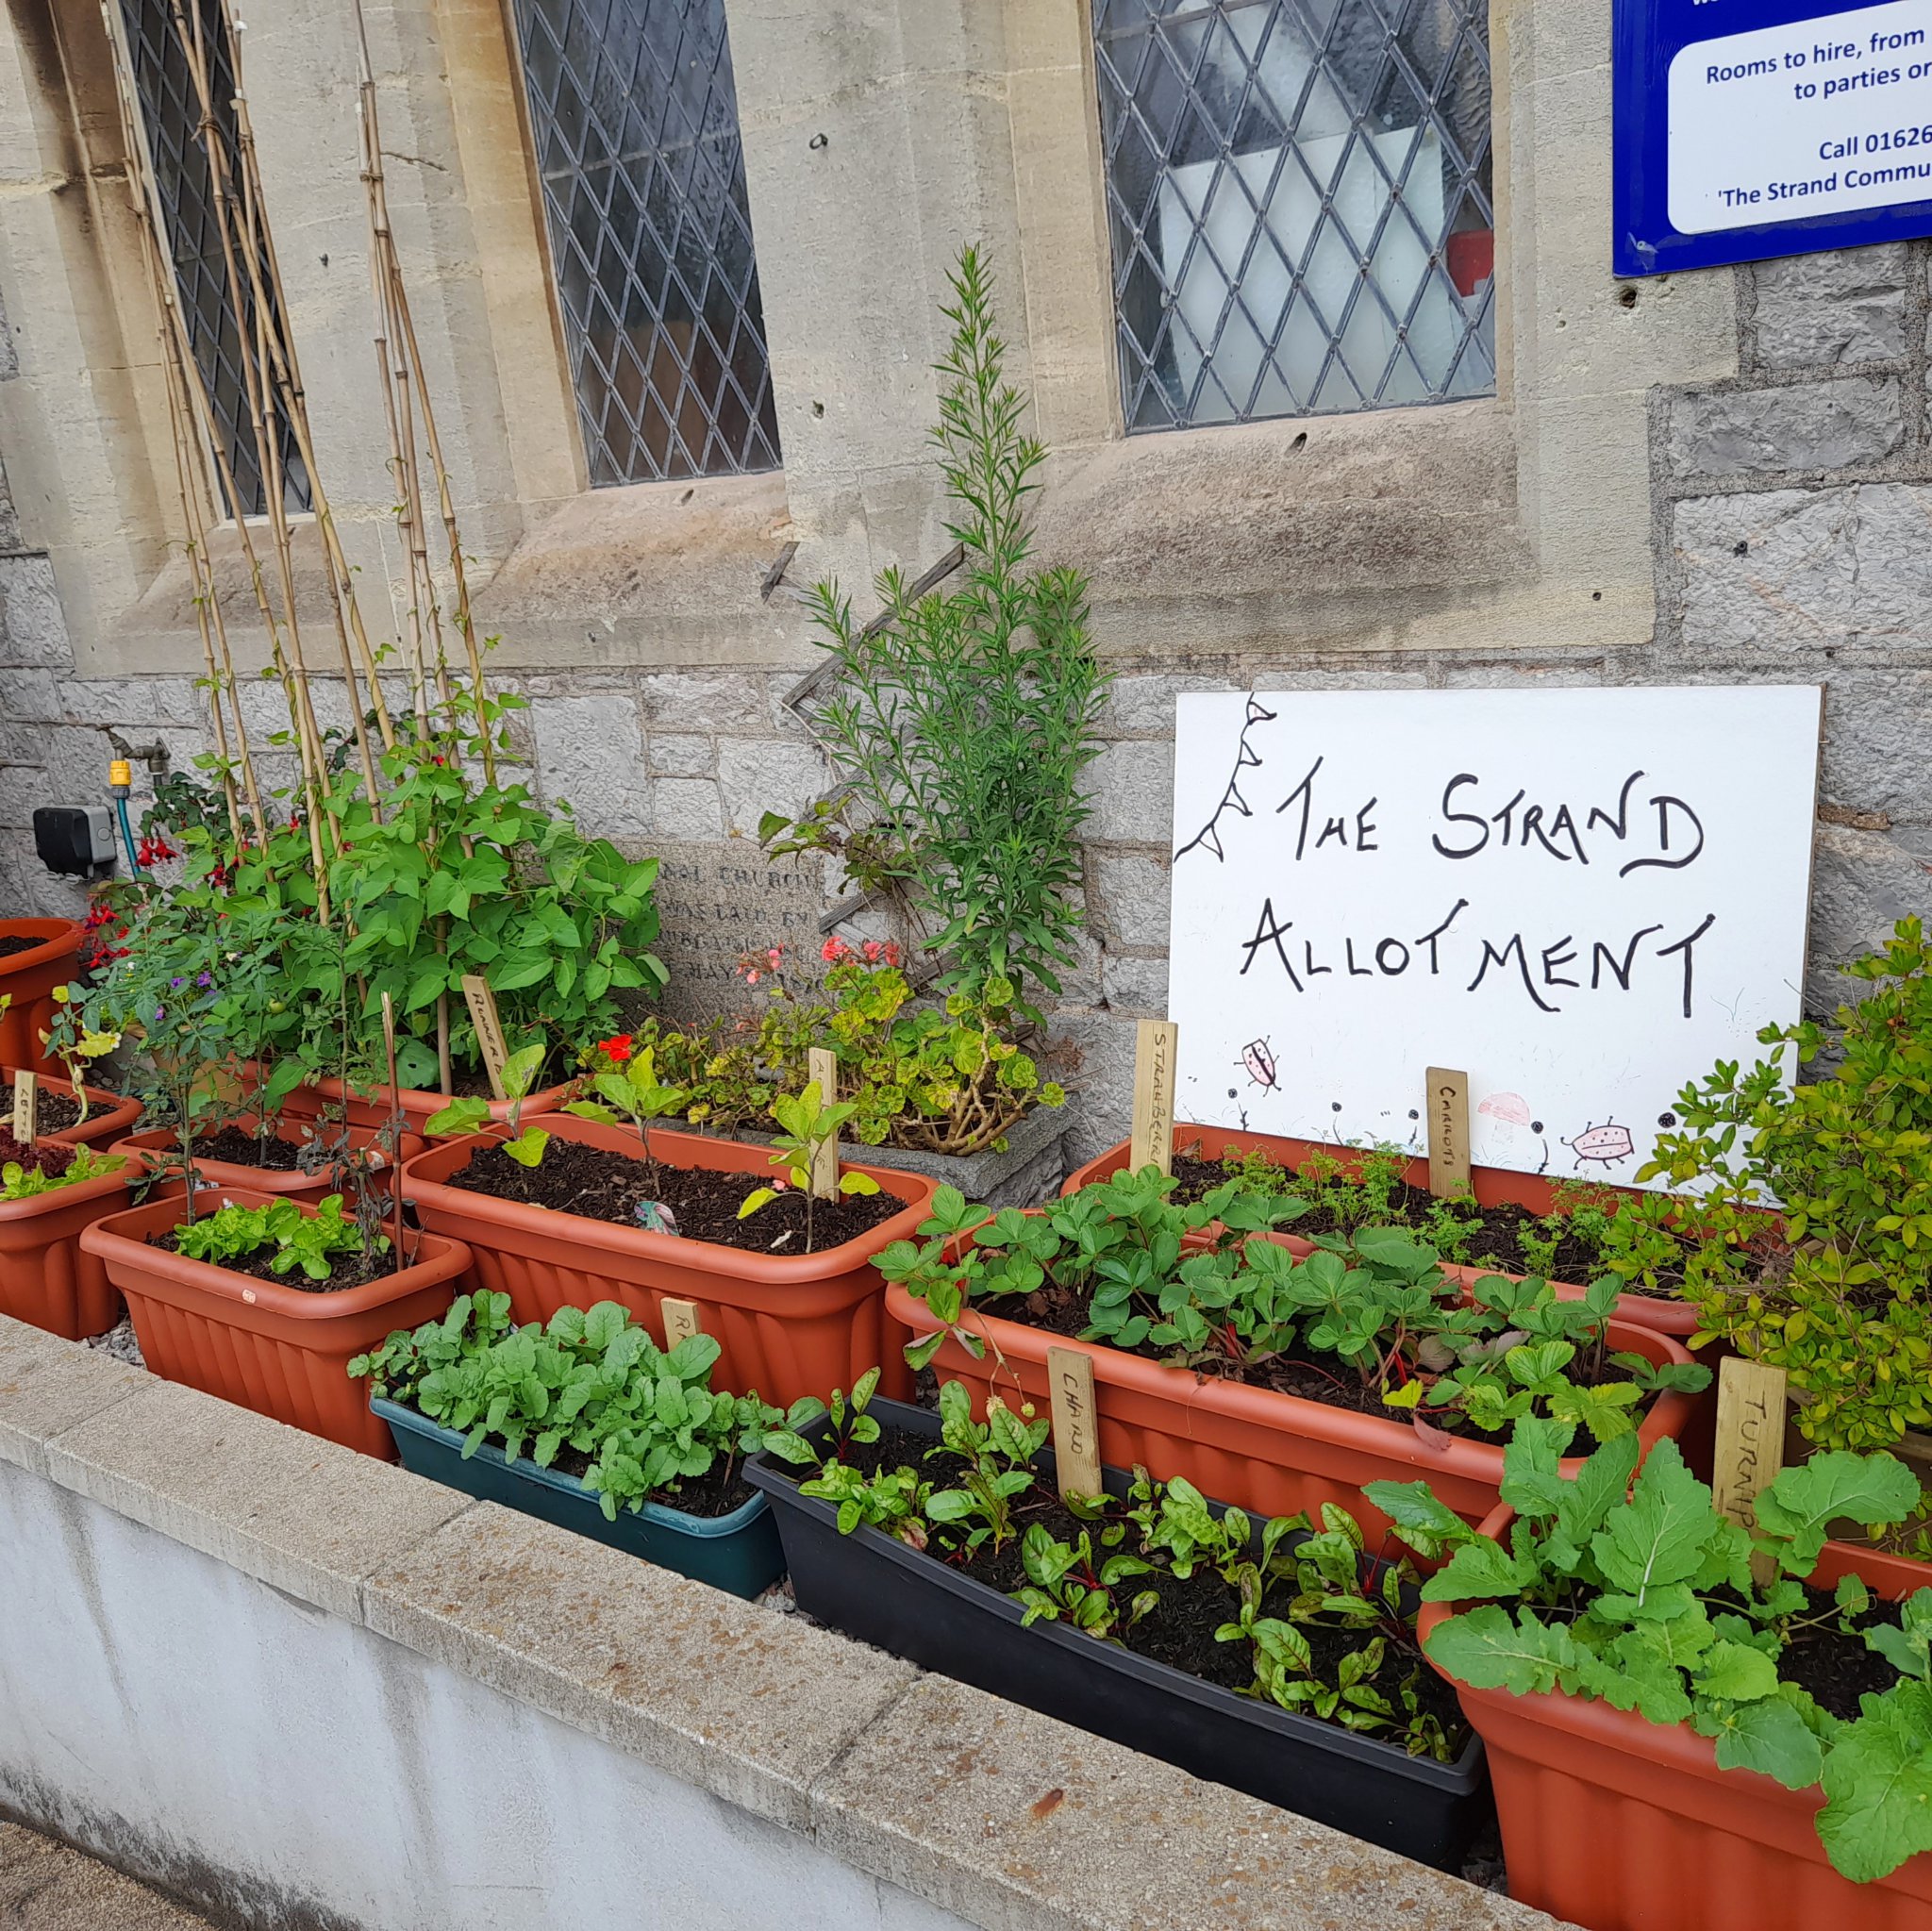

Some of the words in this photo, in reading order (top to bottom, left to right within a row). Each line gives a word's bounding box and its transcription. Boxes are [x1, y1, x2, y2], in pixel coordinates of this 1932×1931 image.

[1706, 58, 1777, 84] Rooms
[1783, 52, 1806, 70] to
[1813, 42, 1862, 64] hire,
[1869, 29, 1925, 53] from
[1794, 83, 1817, 100] to
[1824, 67, 1901, 99] parties
[1819, 136, 1858, 160] Call
[1865, 125, 1932, 153] 01626
[1718, 188, 1761, 208] 'The
[1767, 173, 1838, 201] Strand
[1843, 162, 1931, 189] Commu
[1276, 756, 1379, 860] THE
[1433, 771, 1705, 877] STRAND
[1240, 898, 1716, 1019] ALLOTMENT
[1439, 1086, 1457, 1166] CARROTS
[1062, 1373, 1084, 1455] CHARD
